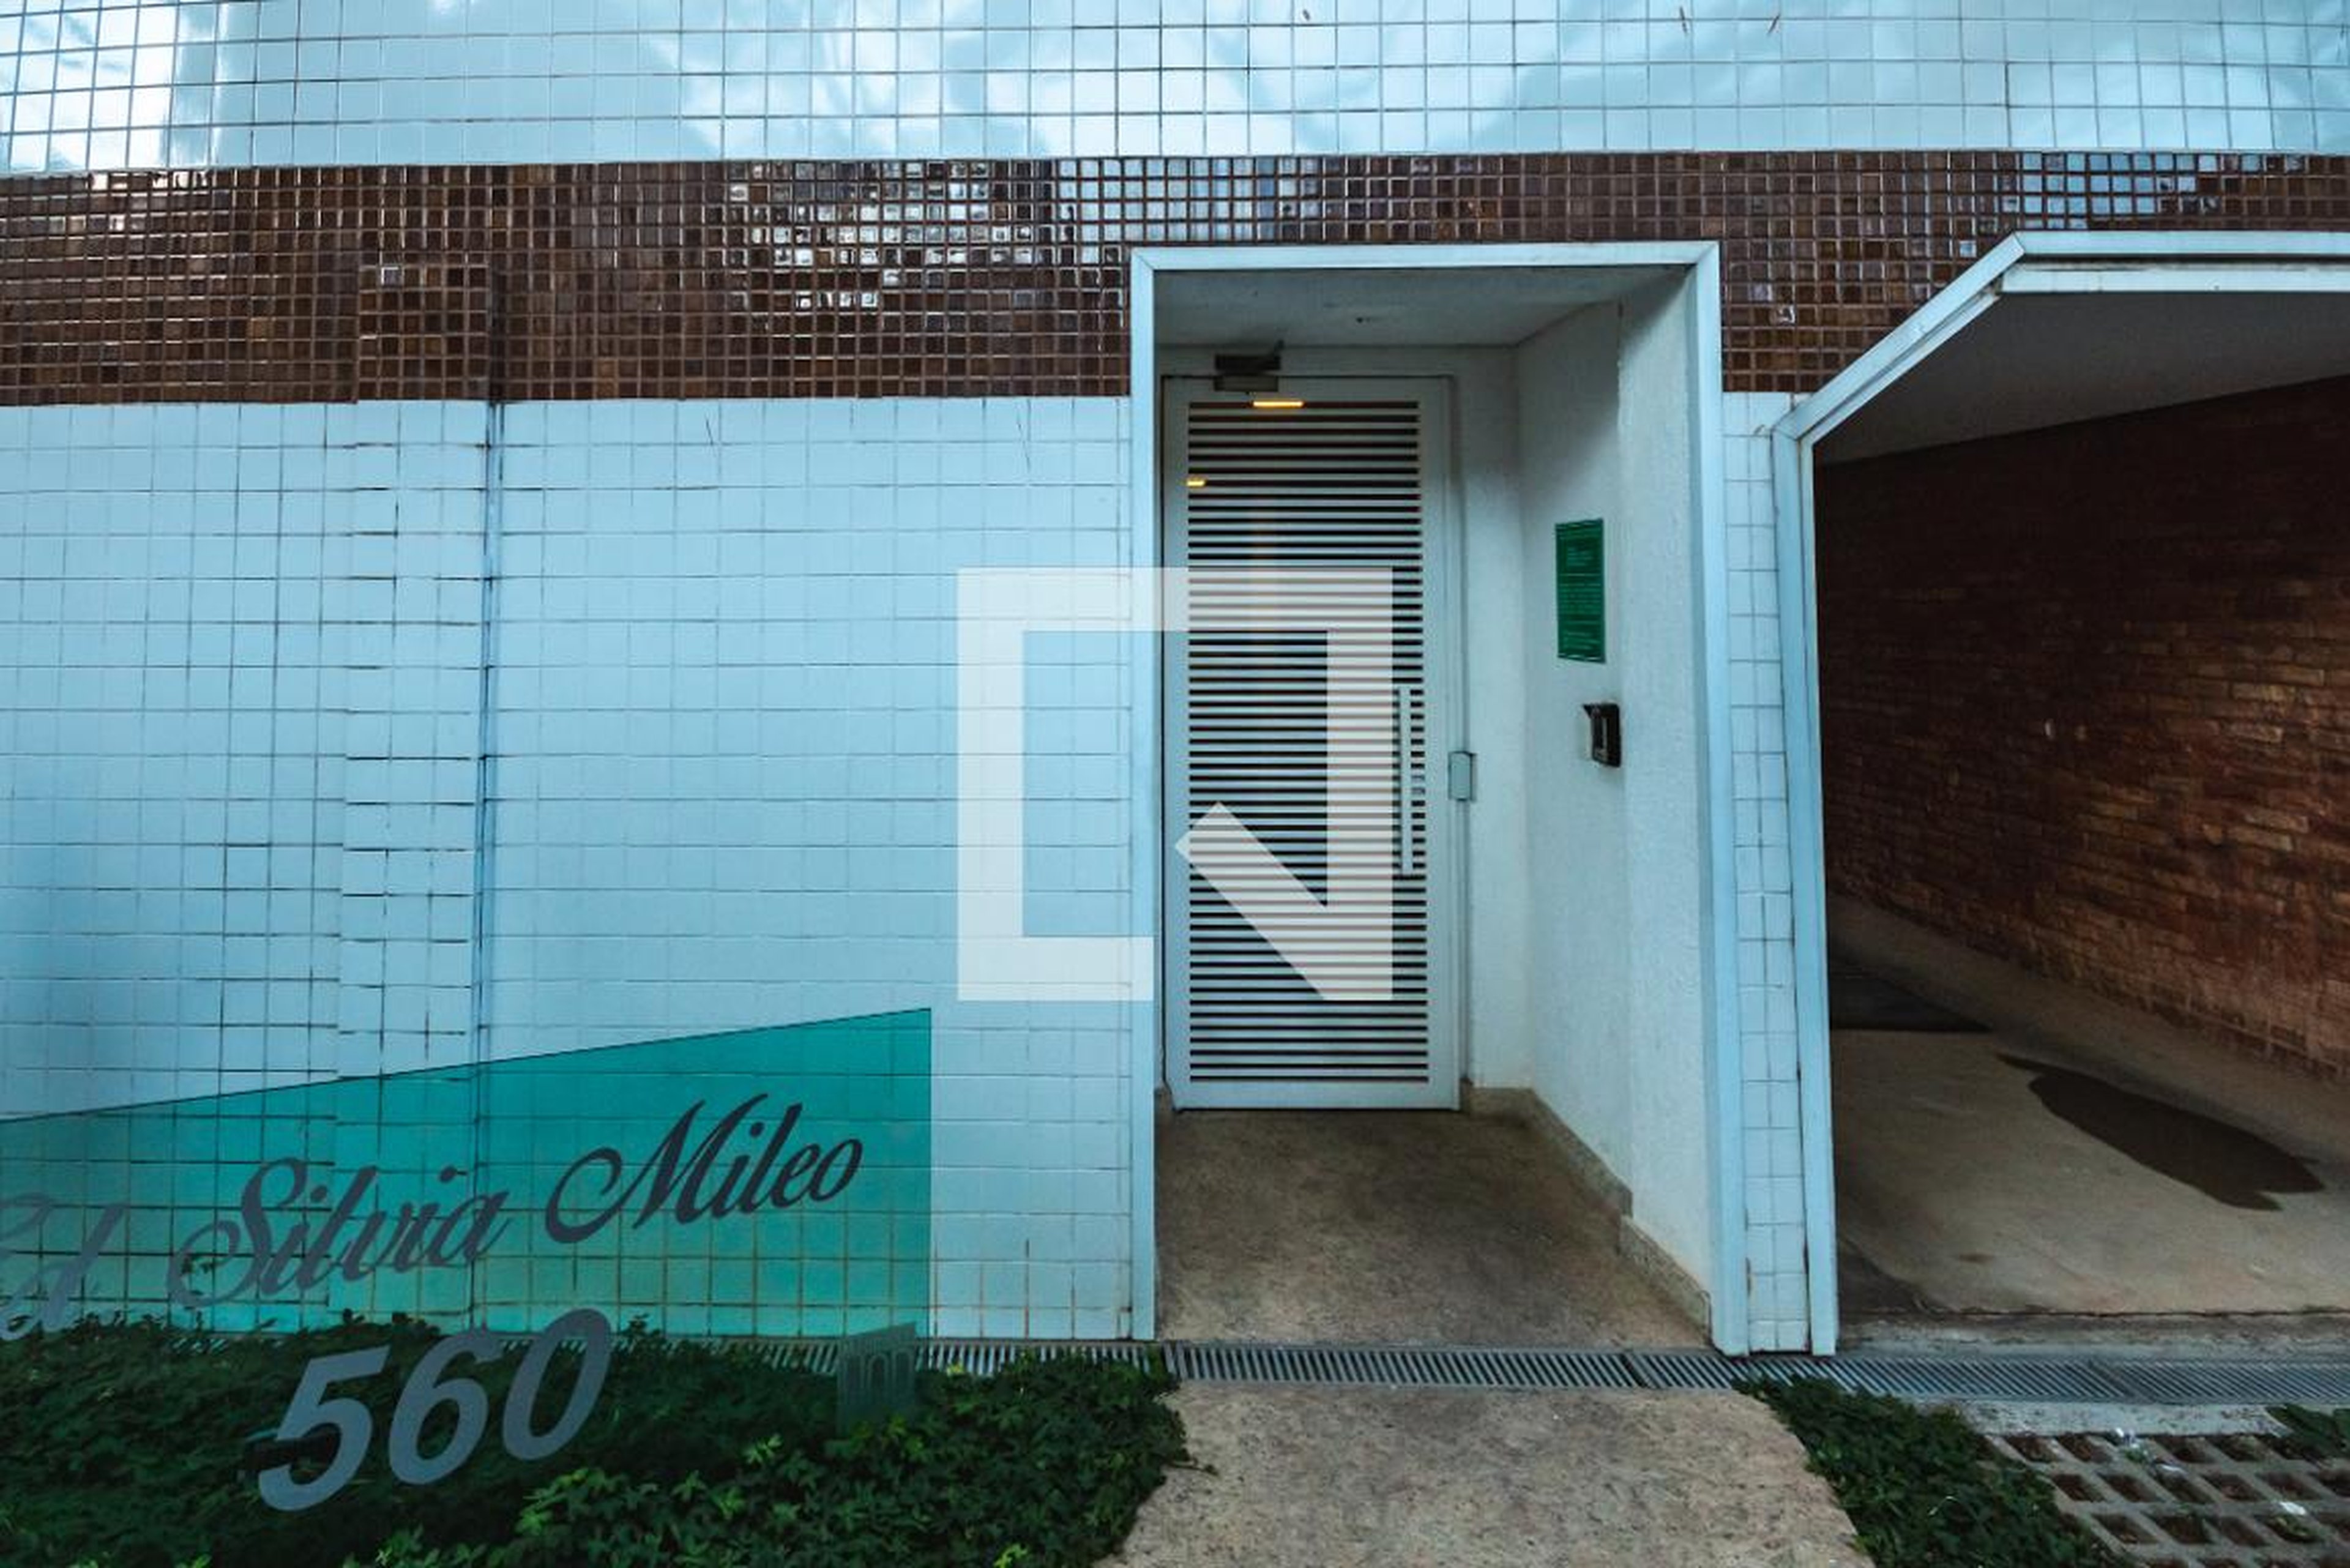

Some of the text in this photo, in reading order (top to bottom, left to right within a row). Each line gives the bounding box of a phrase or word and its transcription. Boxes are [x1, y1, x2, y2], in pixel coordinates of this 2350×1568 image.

[168, 1158, 510, 1307] Silvia
[545, 1094, 863, 1244] Mileo
[258, 1308, 611, 1512] 560
